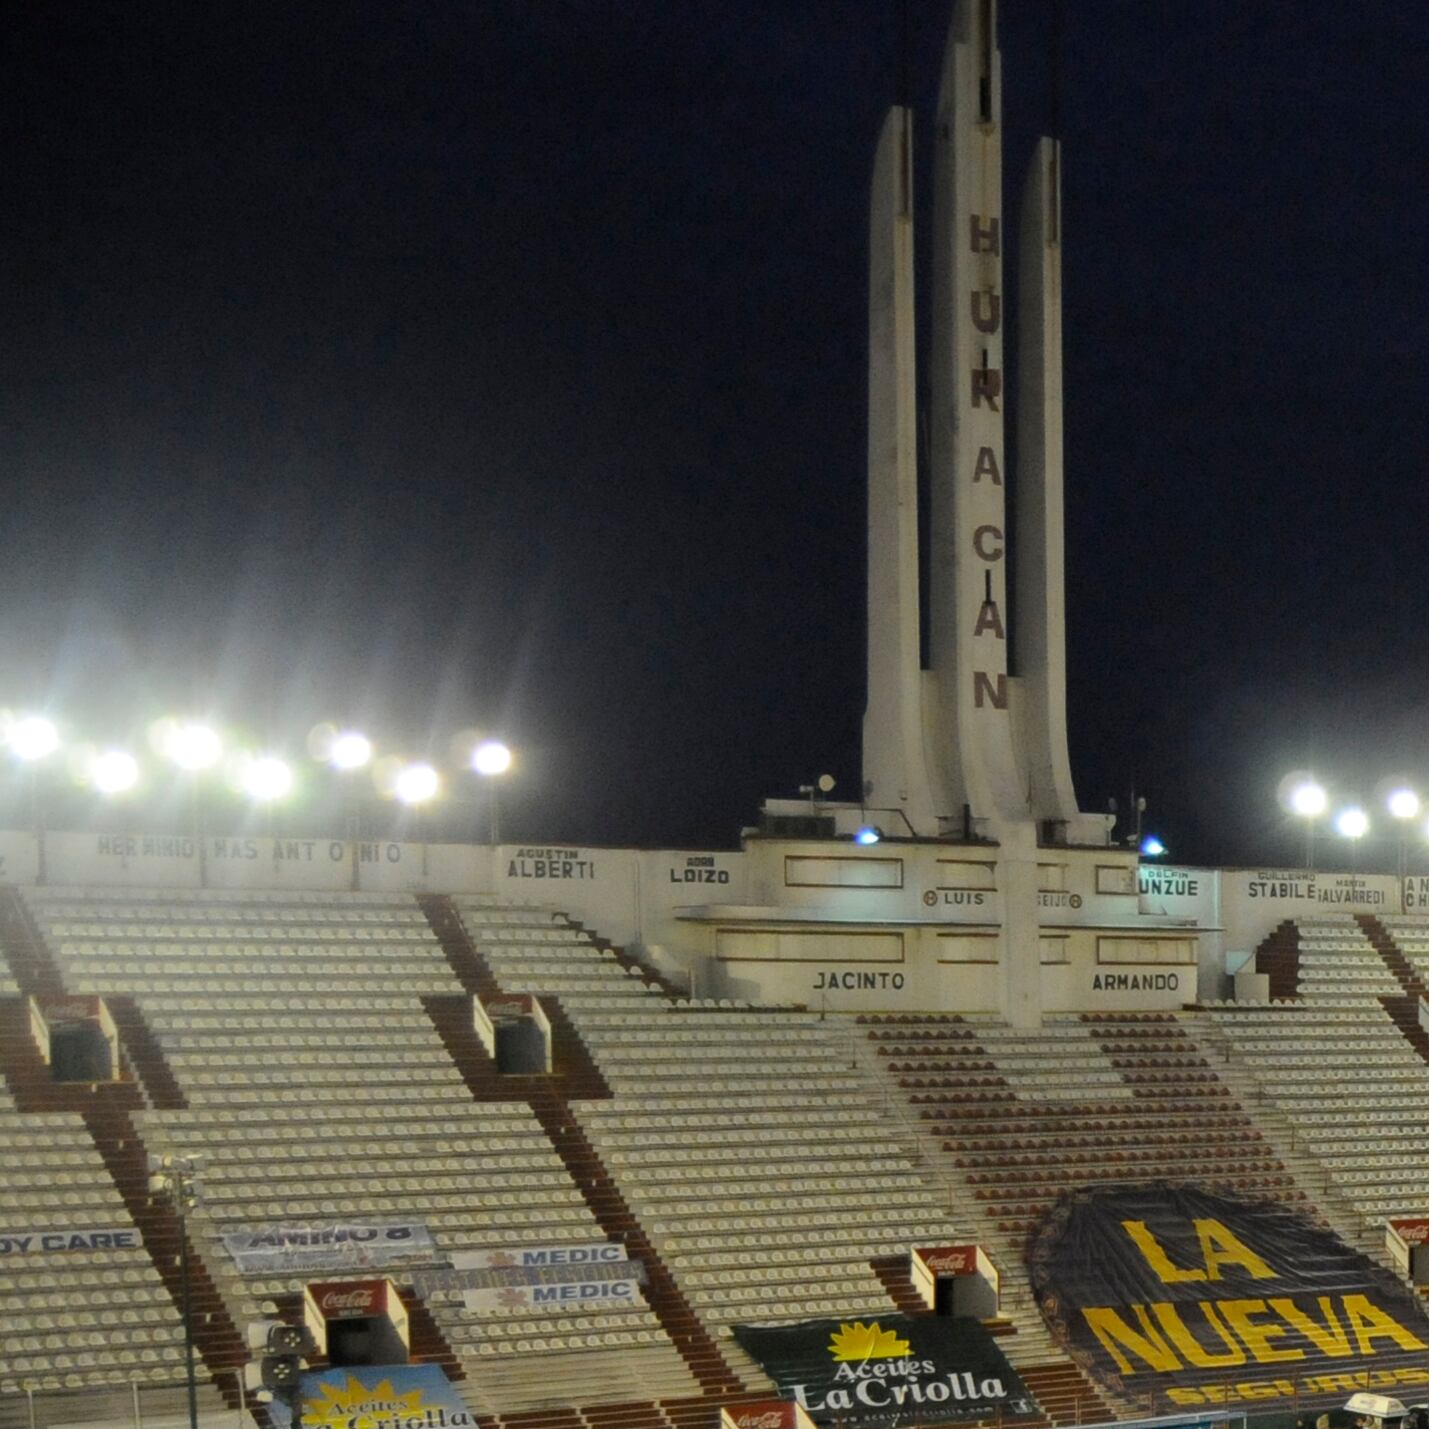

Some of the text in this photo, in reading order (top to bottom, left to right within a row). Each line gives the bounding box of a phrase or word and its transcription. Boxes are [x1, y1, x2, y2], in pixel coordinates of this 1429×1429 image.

[968, 214, 1008, 710] HURACAN
[508, 860, 595, 879] ALBERTI
[670, 868, 730, 884] LOIZO
[1147, 870, 1189, 879] DELFIN
[1138, 879, 1199, 896] UNZUE
[1248, 882, 1316, 899] STABILE
[944, 892, 985, 906] LUIS
[813, 972, 905, 991] JACINTO
[1092, 973, 1179, 991] ARMANDO
[41, 1232, 137, 1252] CARE
[1121, 1218, 1280, 1284] LA
[522, 1247, 621, 1265] MEDIC
[532, 1282, 632, 1302] MEDIC
[1081, 1294, 1429, 1376] NUEVA
[833, 1357, 937, 1381] Aceites
[792, 1371, 1008, 1412] La Criolla
[331, 1399, 409, 1416] Aceites
